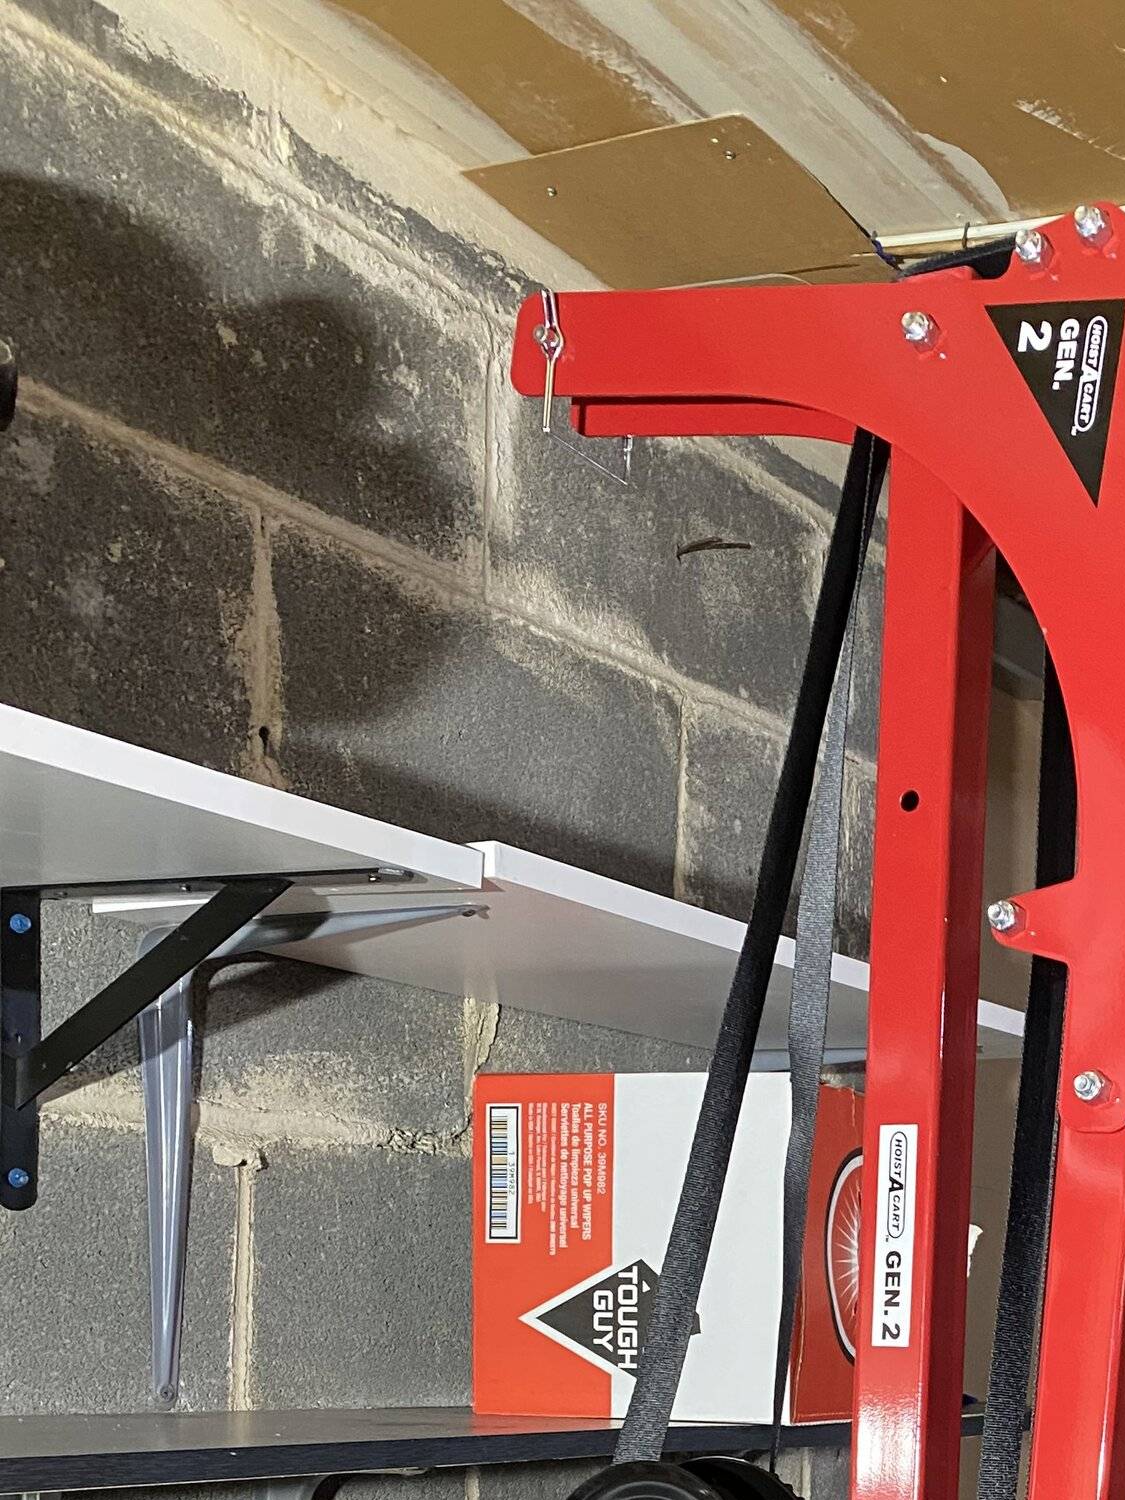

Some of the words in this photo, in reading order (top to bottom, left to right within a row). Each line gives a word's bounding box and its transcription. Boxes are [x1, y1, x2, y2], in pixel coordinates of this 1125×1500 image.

[1017, 320, 1053, 353] 2
[1051, 318, 1080, 391] GEN.
[1088, 323, 1103, 368] HOIST
[1080, 365, 1102, 383] A
[1079, 383, 1094, 424] CART
[560, 1102, 570, 1147] Serviettes
[571, 1103, 582, 1134] Toallas
[583, 1102, 594, 1121] ALL
[598, 1102, 607, 1126] SKU
[560, 1149, 570, 1161] de
[571, 1135, 582, 1147] de
[582, 1122, 594, 1167] PURPOSE
[597, 1128, 607, 1150] NO.
[893, 1138, 903, 1178] HOIST
[557, 1162, 569, 1207] nettoyage
[568, 1148, 581, 1187] limpieza
[582, 1168, 593, 1188] POP
[596, 1151, 607, 1195] 39M982
[888, 1175, 904, 1193] A
[570, 1188, 580, 1229] universal
[582, 1189, 593, 1203] UP
[891, 1195, 901, 1232] CART
[558, 1207, 568, 1249] universal
[581, 1204, 592, 1241] WIPERS
[883, 1250, 902, 1316] GEN.
[592, 1289, 614, 1353] GUY
[617, 1265, 639, 1369] TOUGH
[881, 1322, 901, 1341] 2
